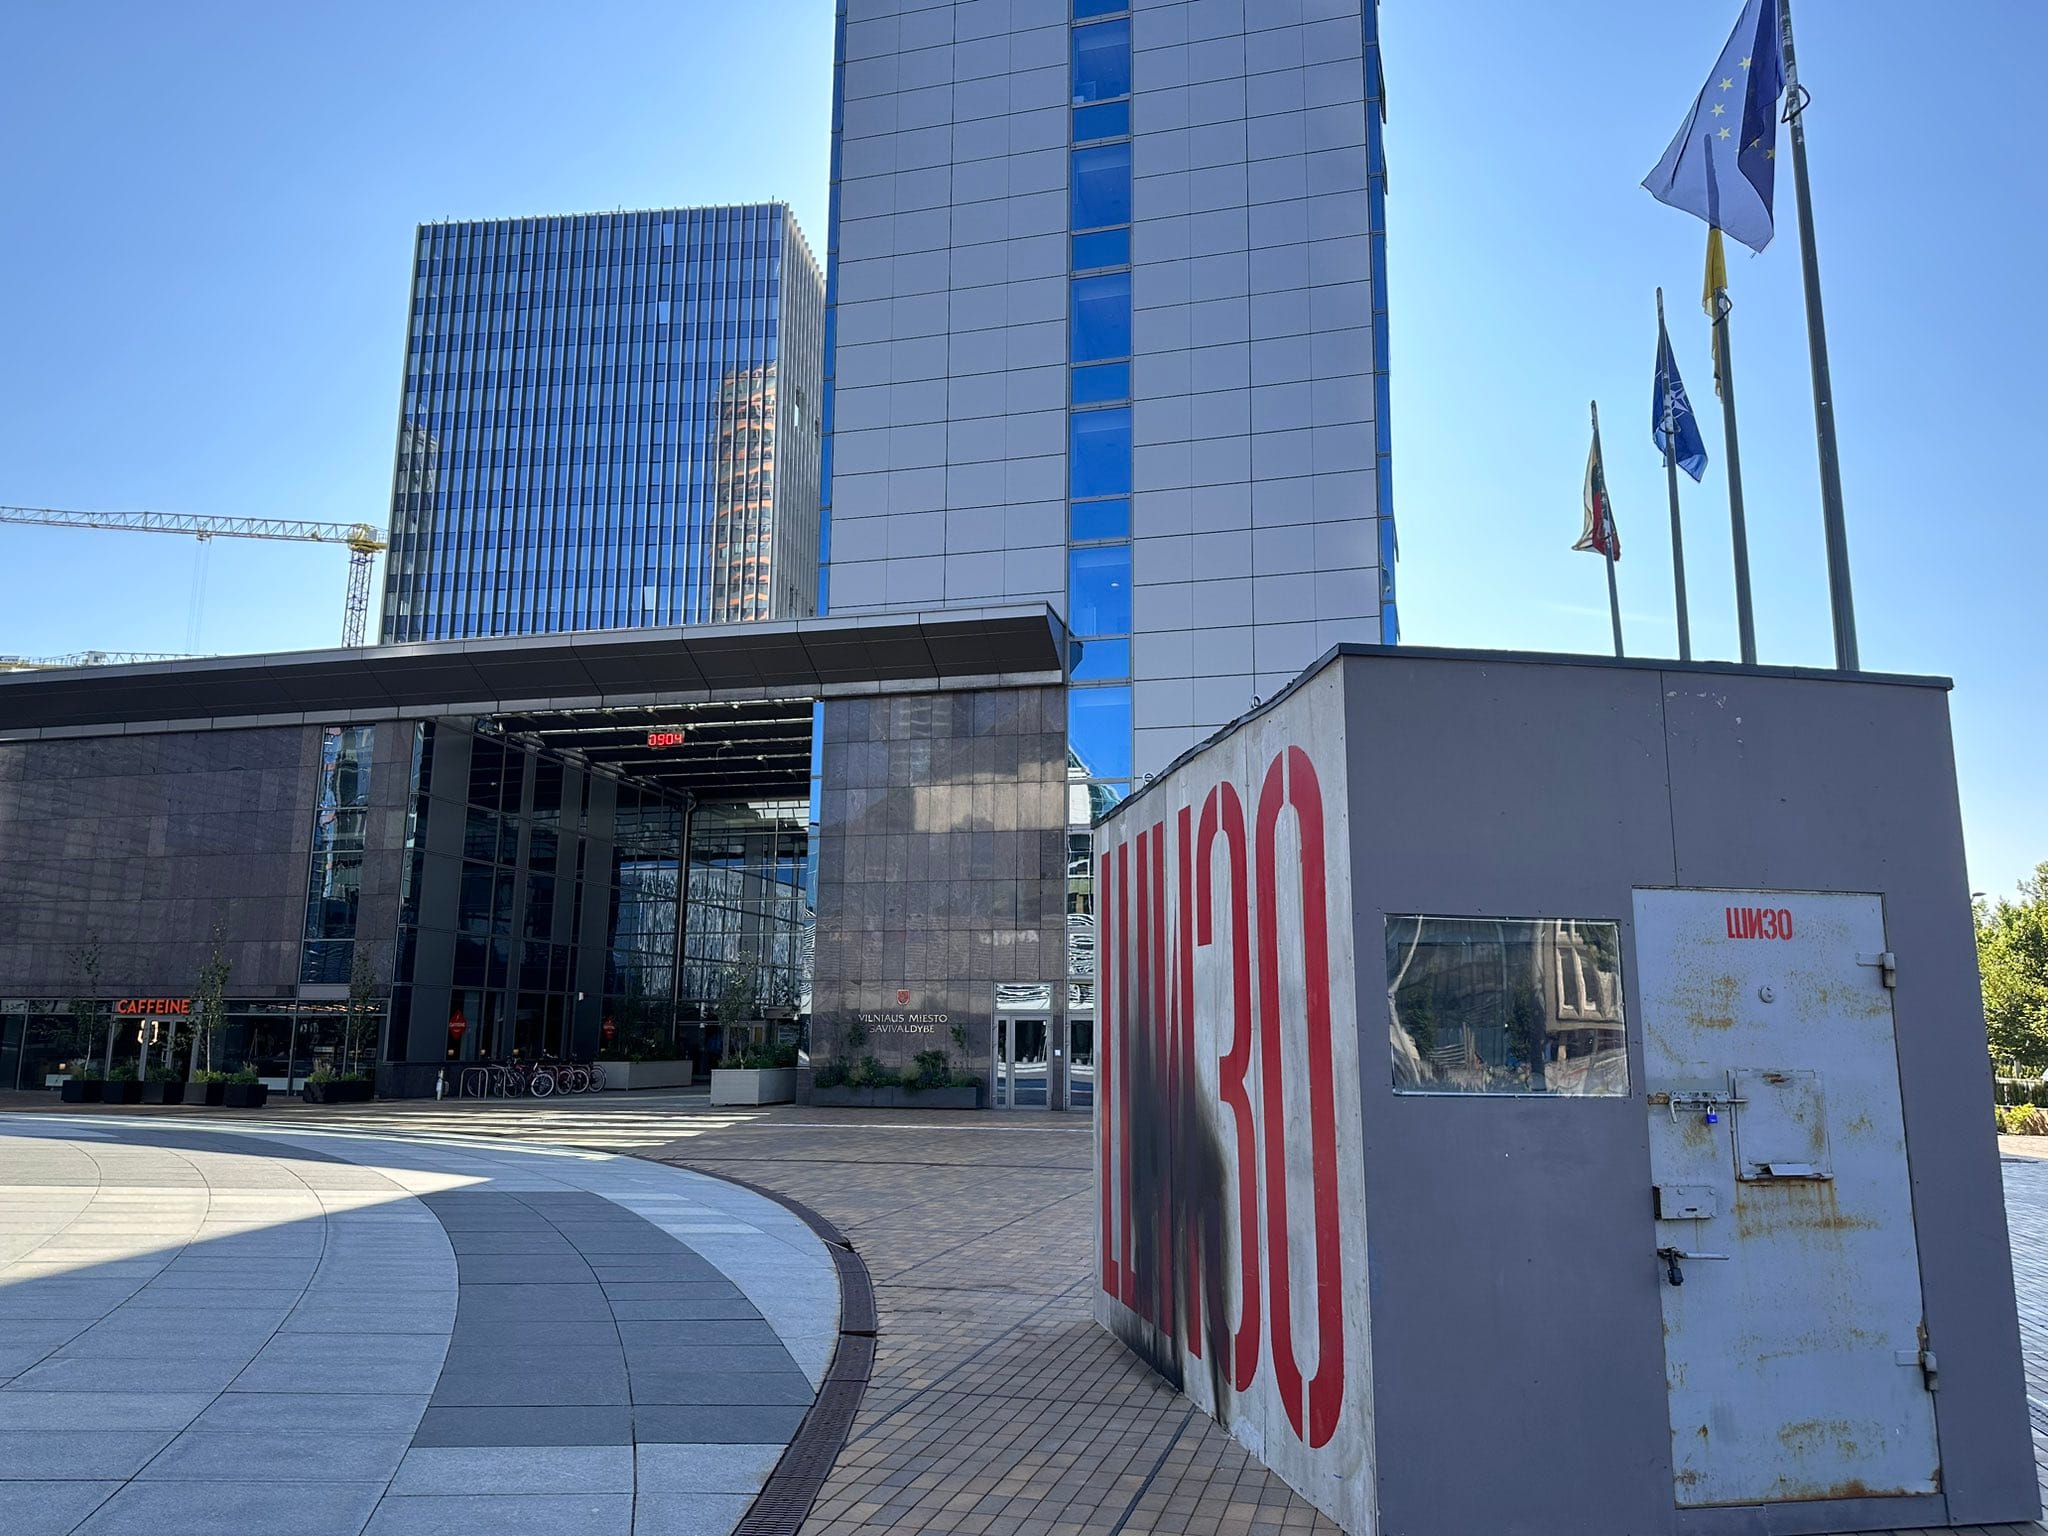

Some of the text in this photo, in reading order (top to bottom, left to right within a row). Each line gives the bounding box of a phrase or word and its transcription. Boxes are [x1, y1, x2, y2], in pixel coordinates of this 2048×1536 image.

[1726, 907, 1793, 941] ШИЗО
[117, 999, 192, 1014] CAFFEINE
[858, 1014, 948, 1023] VILNIAUS MIESTO
[1101, 745, 1344, 1449] ШИЗО
